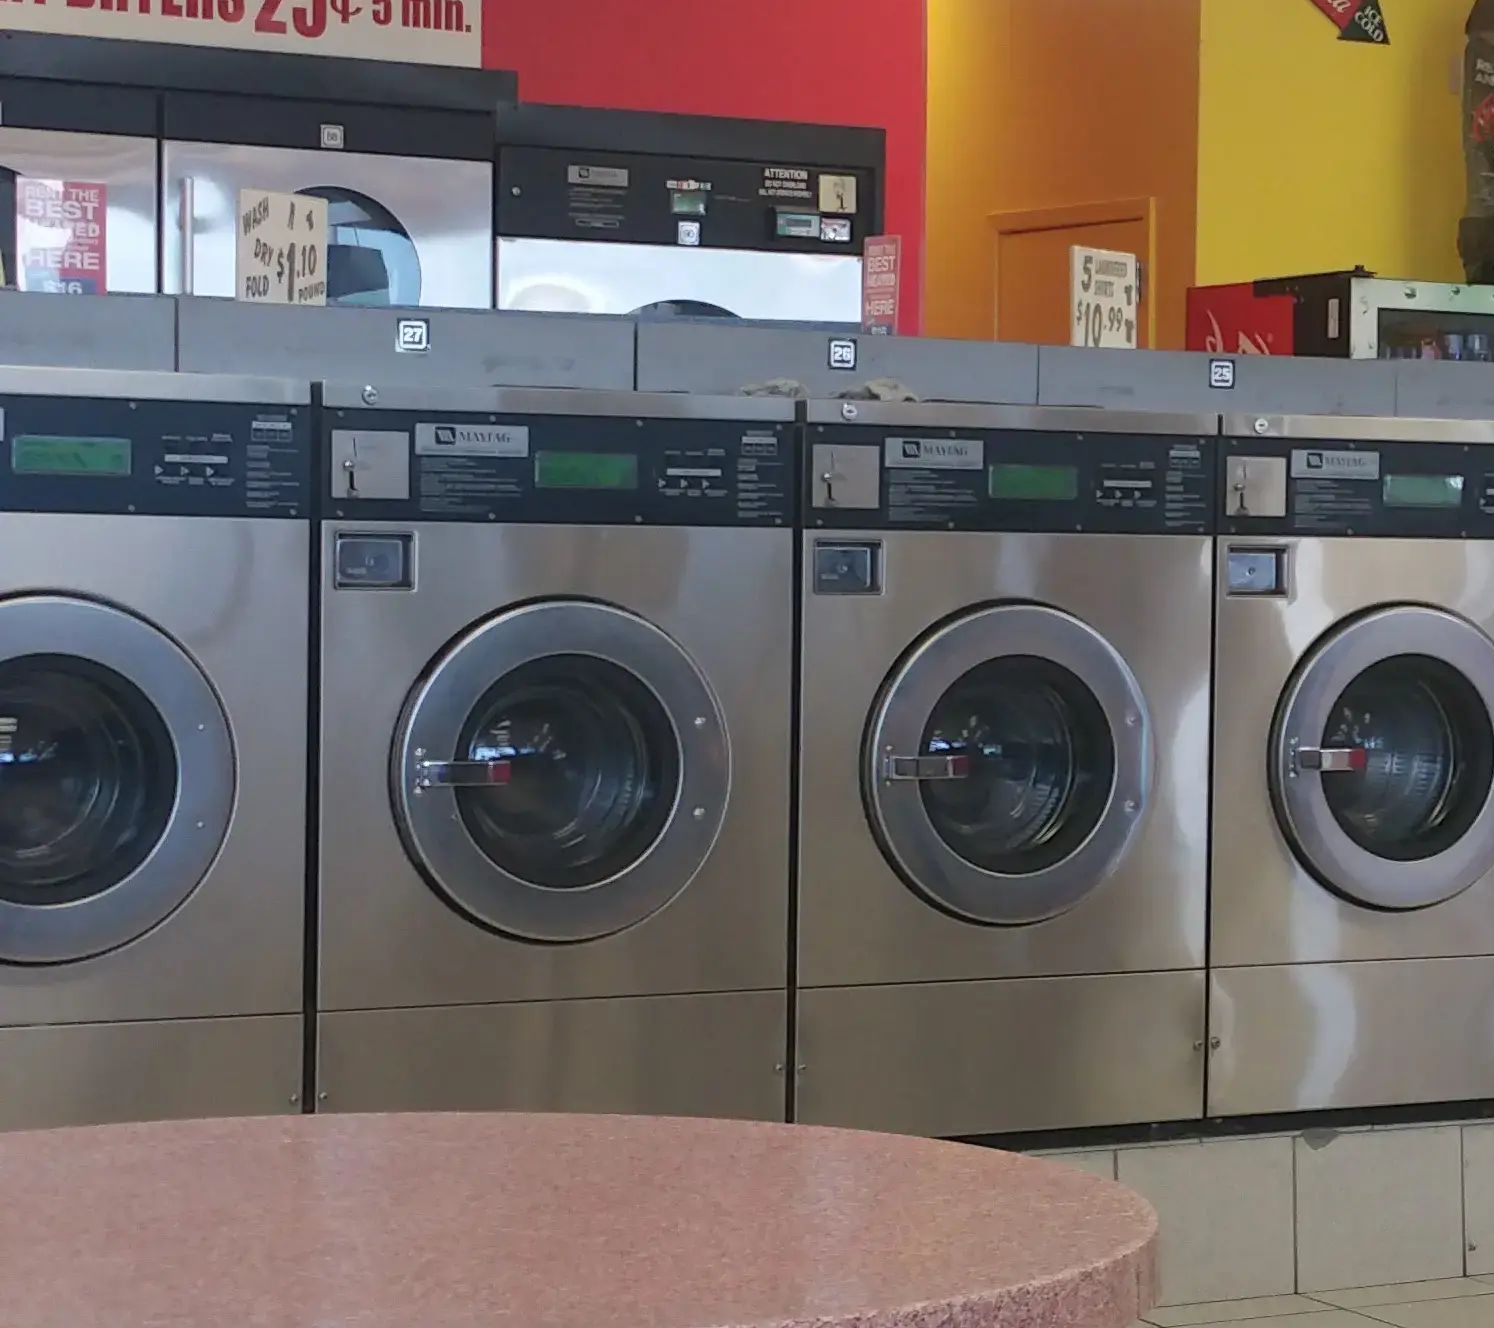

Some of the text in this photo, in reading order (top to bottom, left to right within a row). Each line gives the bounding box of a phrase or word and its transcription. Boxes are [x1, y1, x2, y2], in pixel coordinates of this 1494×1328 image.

[1354, 11, 1384, 42] COLD
[68, 188, 100, 202] THE
[25, 201, 100, 221] BEST
[242, 196, 270, 236] WASH
[28, 250, 101, 270] HERE
[253, 238, 274, 267] DRY
[867, 256, 896, 272] BEST
[1081, 255, 1094, 292] 5
[245, 274, 270, 298] FOLD
[403, 327, 423, 342] 27
[834, 346, 852, 361] 26
[1214, 366, 1231, 382] 25
